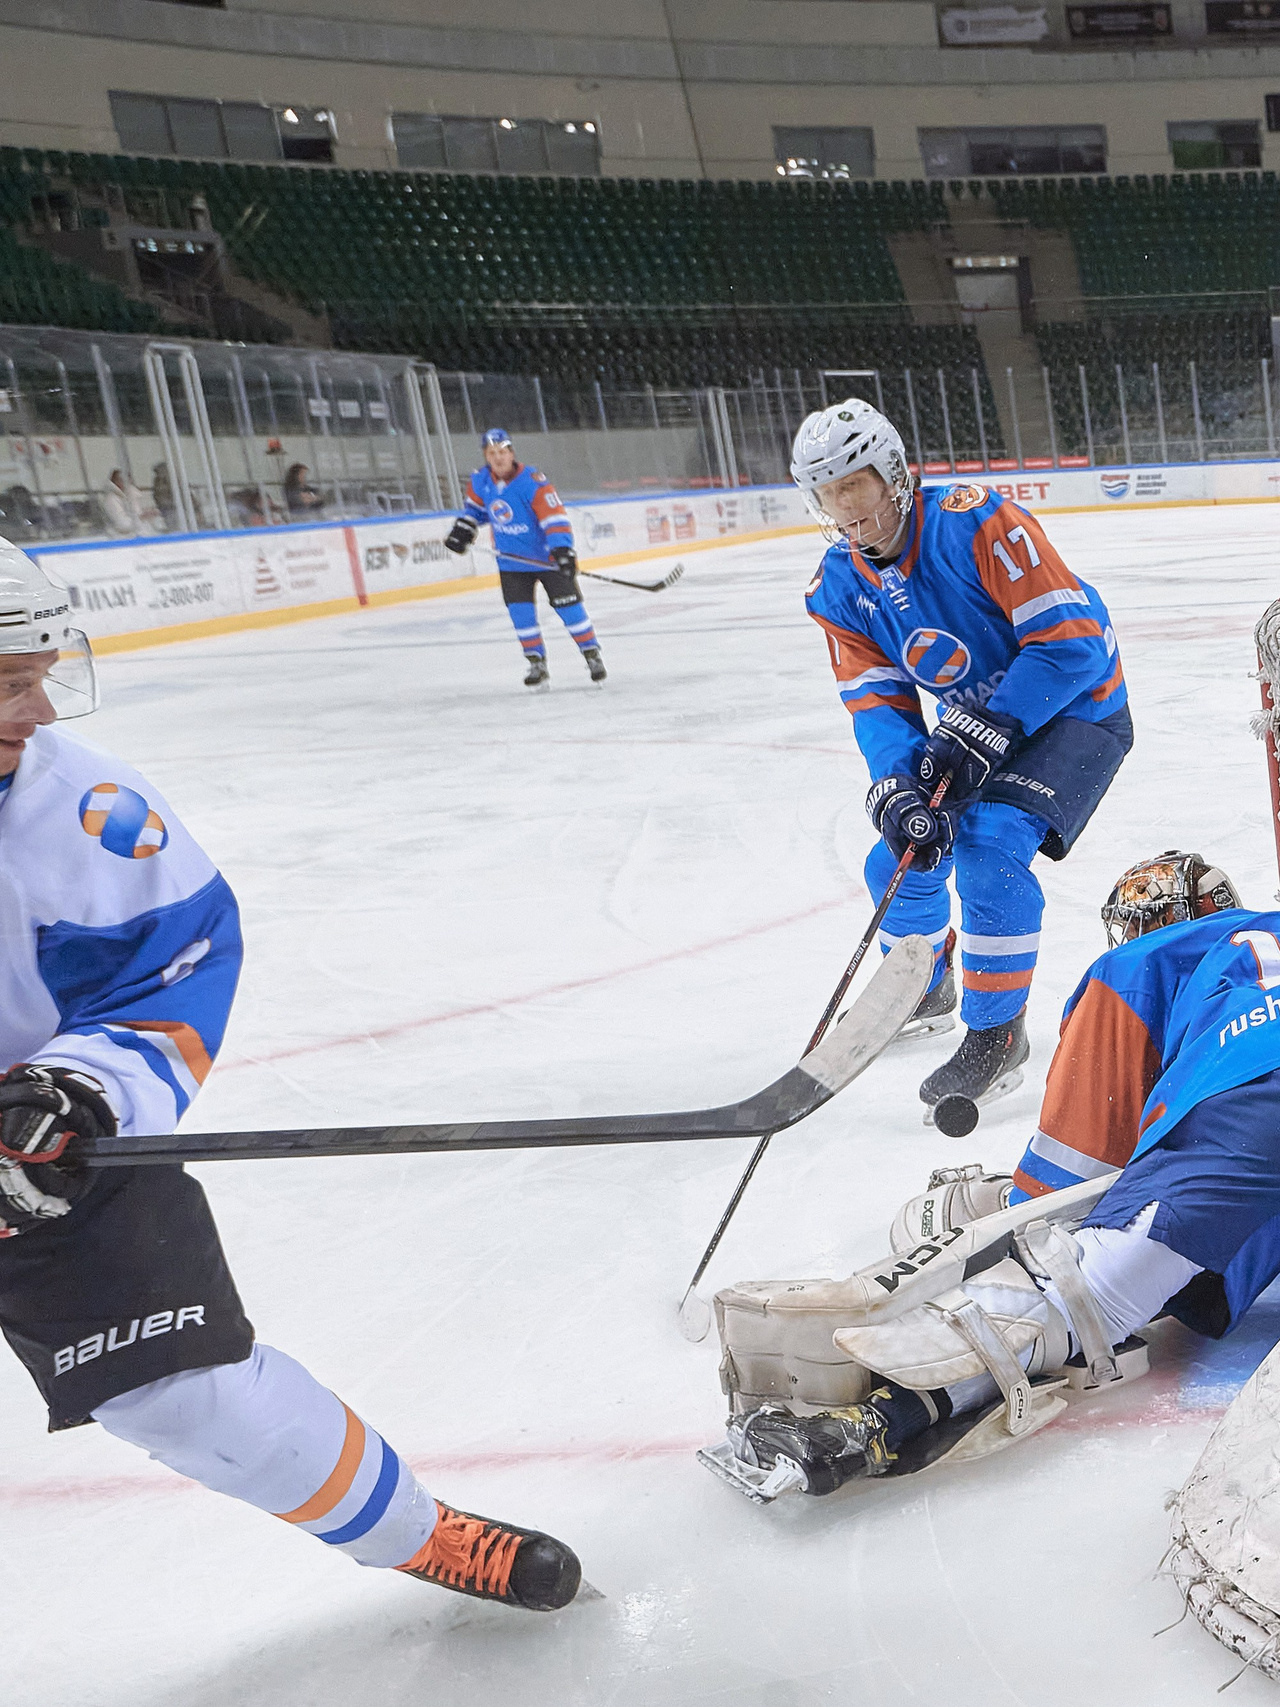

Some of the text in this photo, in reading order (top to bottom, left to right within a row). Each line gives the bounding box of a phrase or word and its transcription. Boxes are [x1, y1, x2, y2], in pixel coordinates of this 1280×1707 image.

[993, 525, 1041, 582] 17
[33, 604, 69, 621] BAUER
[993, 772, 1056, 799] BAUER
[874, 1226, 965, 1294] CCM
[53, 1303, 207, 1379] BAUER
[1016, 1387, 1024, 1419] CCM
